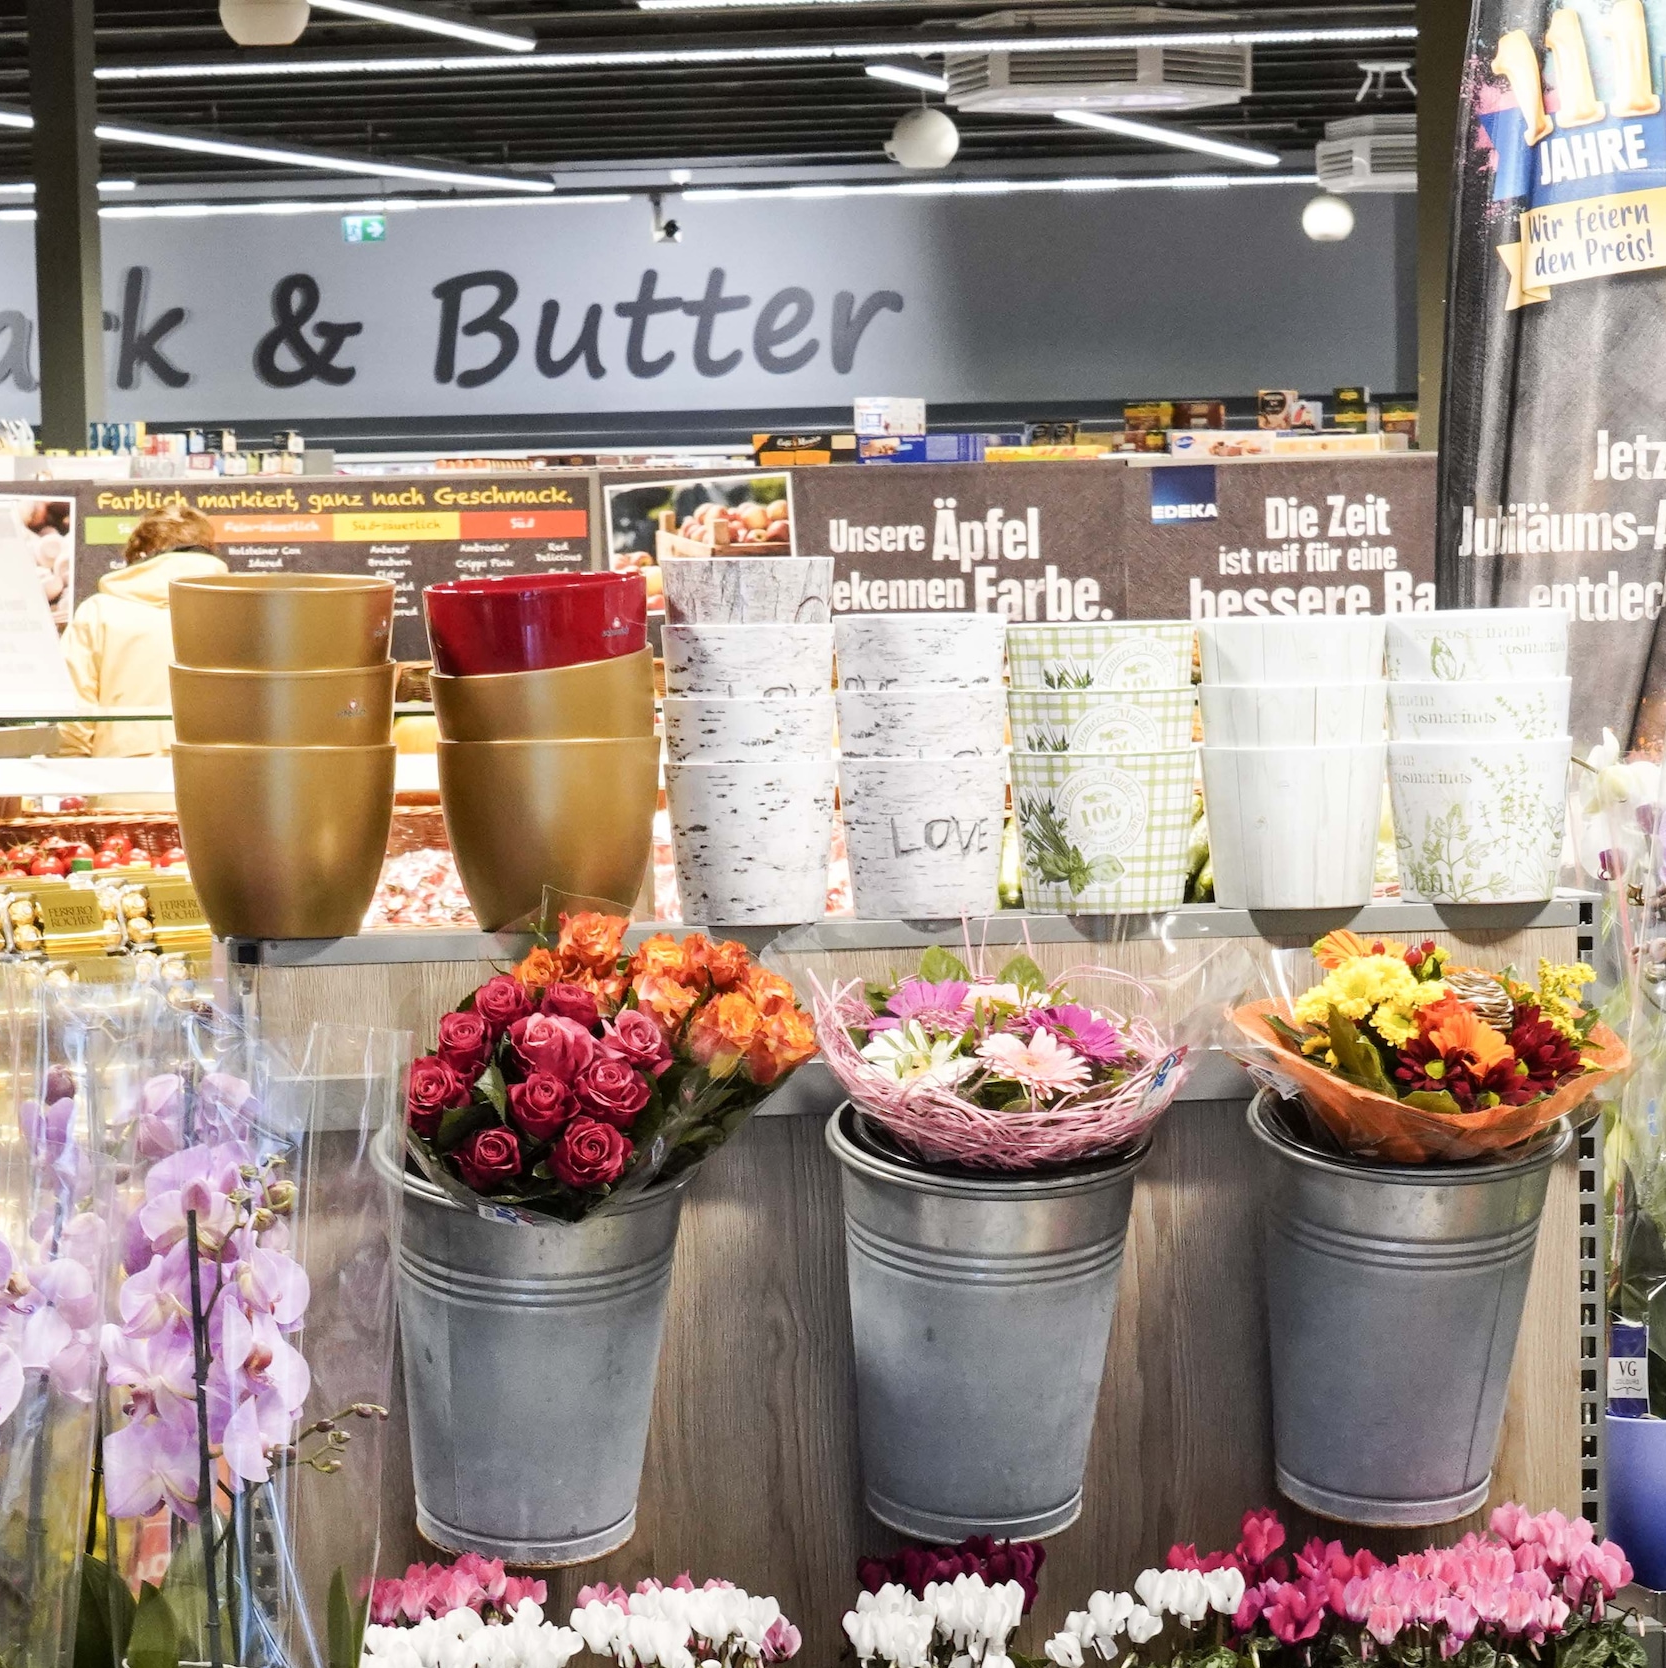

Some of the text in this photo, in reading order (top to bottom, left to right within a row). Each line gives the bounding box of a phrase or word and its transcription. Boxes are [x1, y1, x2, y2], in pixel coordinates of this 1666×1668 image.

[1539, 123, 1649, 187] JAHRE
[1528, 202, 1651, 245] Wir feiern
[1534, 228, 1656, 278] den Preis!
[251, 270, 364, 390] &
[431, 267, 906, 389] Butter
[96, 485, 575, 514] Farblich markiert, ganz nach Geschmack.
[1151, 503, 1219, 519] EDEKA
[1264, 493, 1391, 540] Die Zeit
[828, 497, 1041, 562] Unsere Äpfel
[1218, 540, 1397, 575] ist reif für eine
[832, 565, 1114, 622] ekennen Farbe.
[1190, 568, 1437, 618] bessere Ba
[889, 814, 990, 860] LOVE
[1080, 803, 1123, 828] 100
[47, 906, 93, 920] FERRERO
[49, 915, 96, 929] ROCHER
[1618, 1360, 1637, 1376] VG
